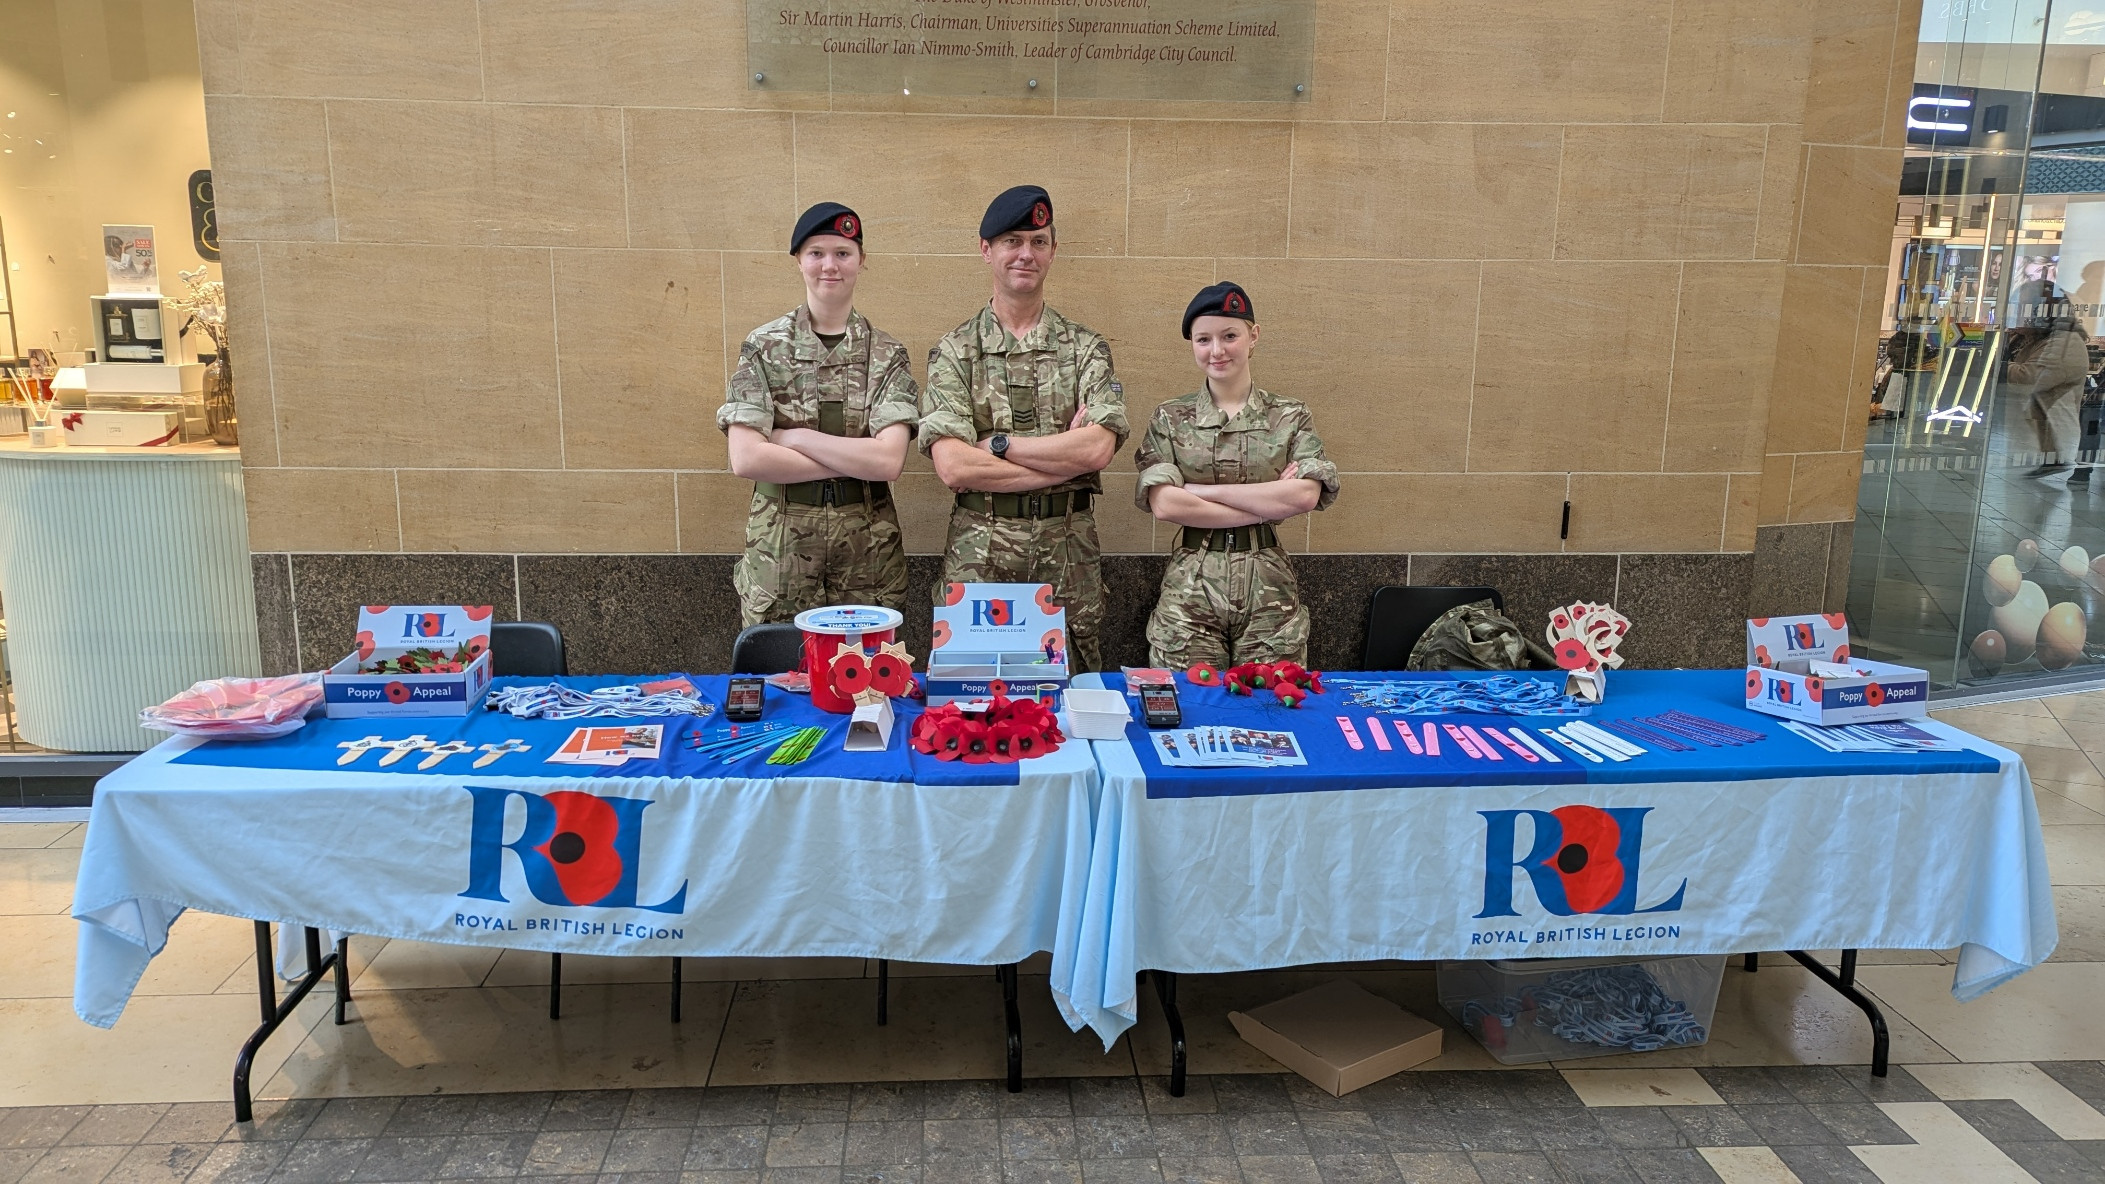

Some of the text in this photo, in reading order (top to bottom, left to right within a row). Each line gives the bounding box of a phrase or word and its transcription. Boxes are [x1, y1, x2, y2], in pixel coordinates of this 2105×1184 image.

[779, 10, 1280, 38] Sir Martin Harris, Chairman, Universities Superannuation Scheme Limited,
[823, 38, 1237, 66] Councillor Ian Nimmo-Smith, Leader of Cambridge City Council.
[347, 686, 452, 699] Poppy Appeal
[961, 684, 987, 694] Poppy
[1839, 686, 1917, 703] Poppy Appeal
[455, 913, 684, 940] ROYAL BRITISH LEGION
[1471, 925, 1680, 945] ROYAL BRITISH LEGION
